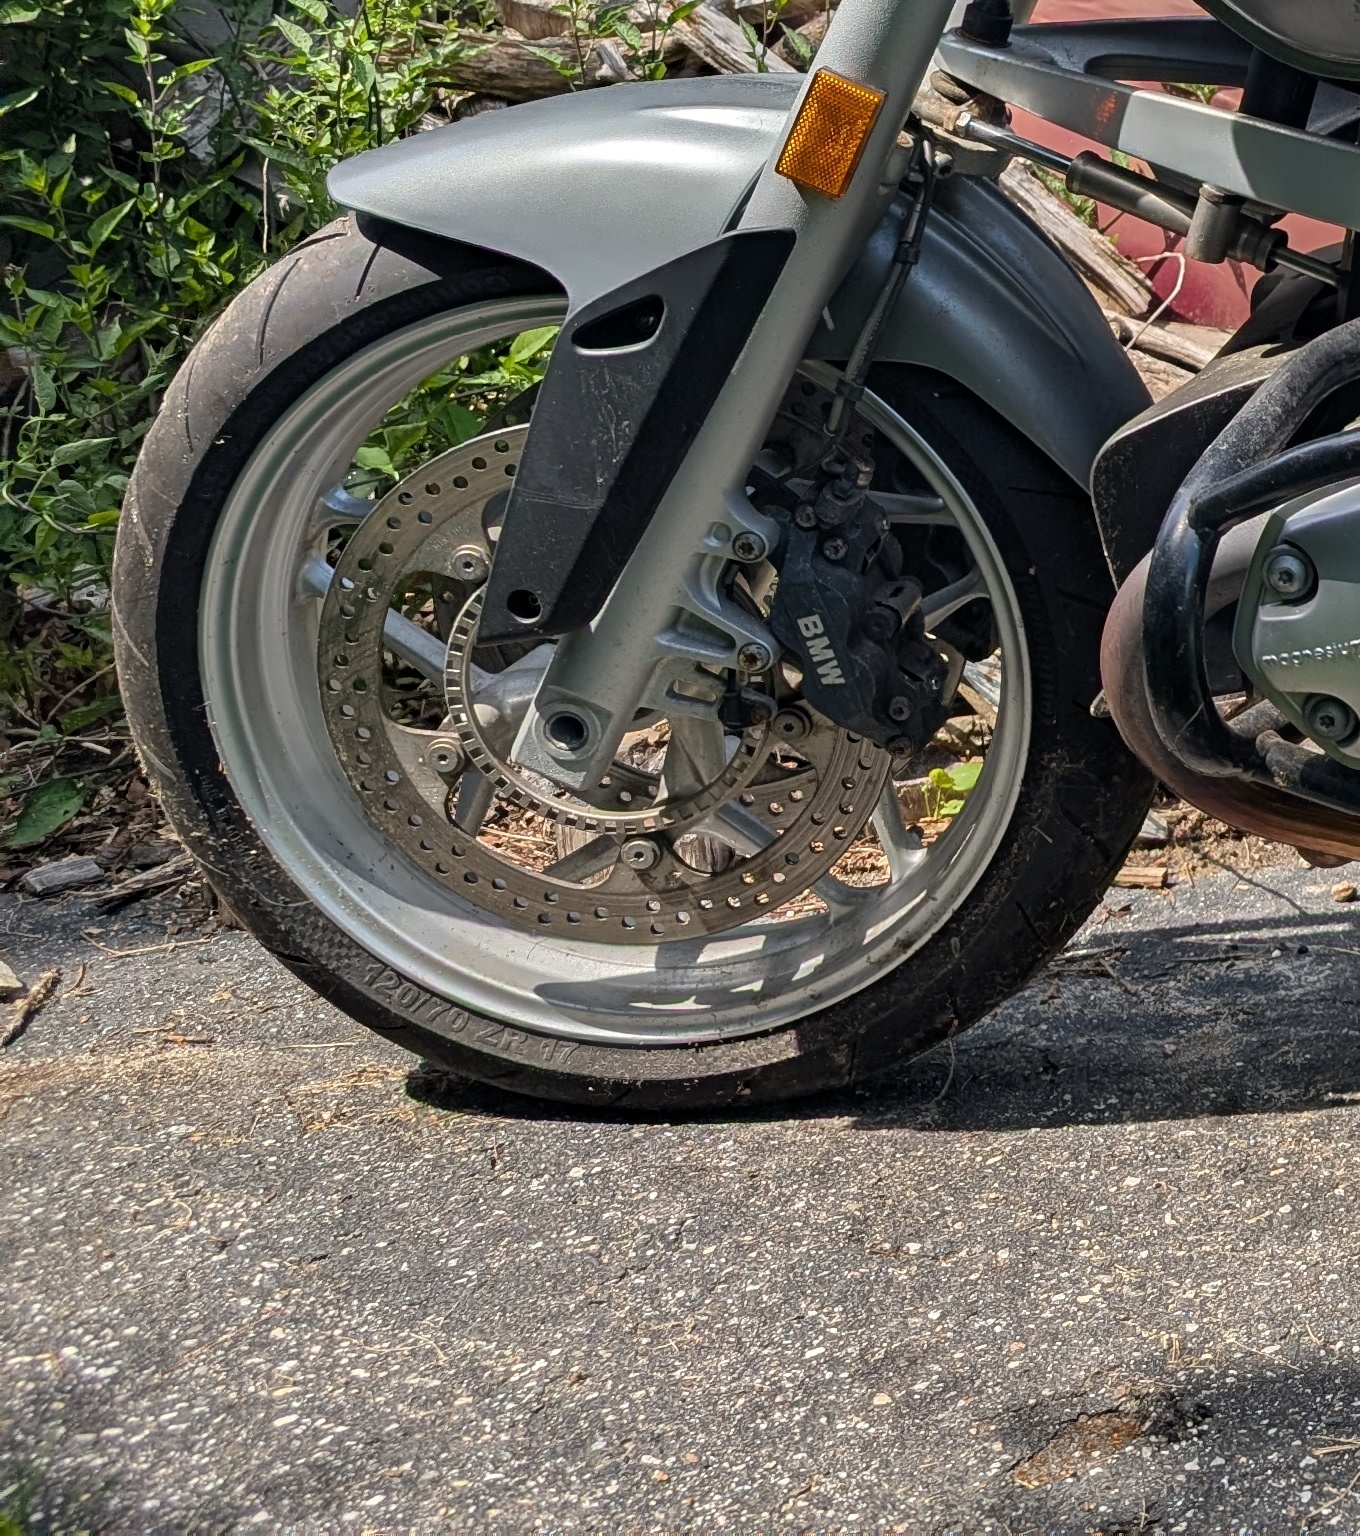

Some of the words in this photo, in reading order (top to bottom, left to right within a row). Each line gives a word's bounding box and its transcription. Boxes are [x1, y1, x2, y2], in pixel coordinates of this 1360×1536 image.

[797, 614, 846, 685] BMW
[363, 963, 470, 1033] 120/70
[539, 1038, 579, 1064] 17
